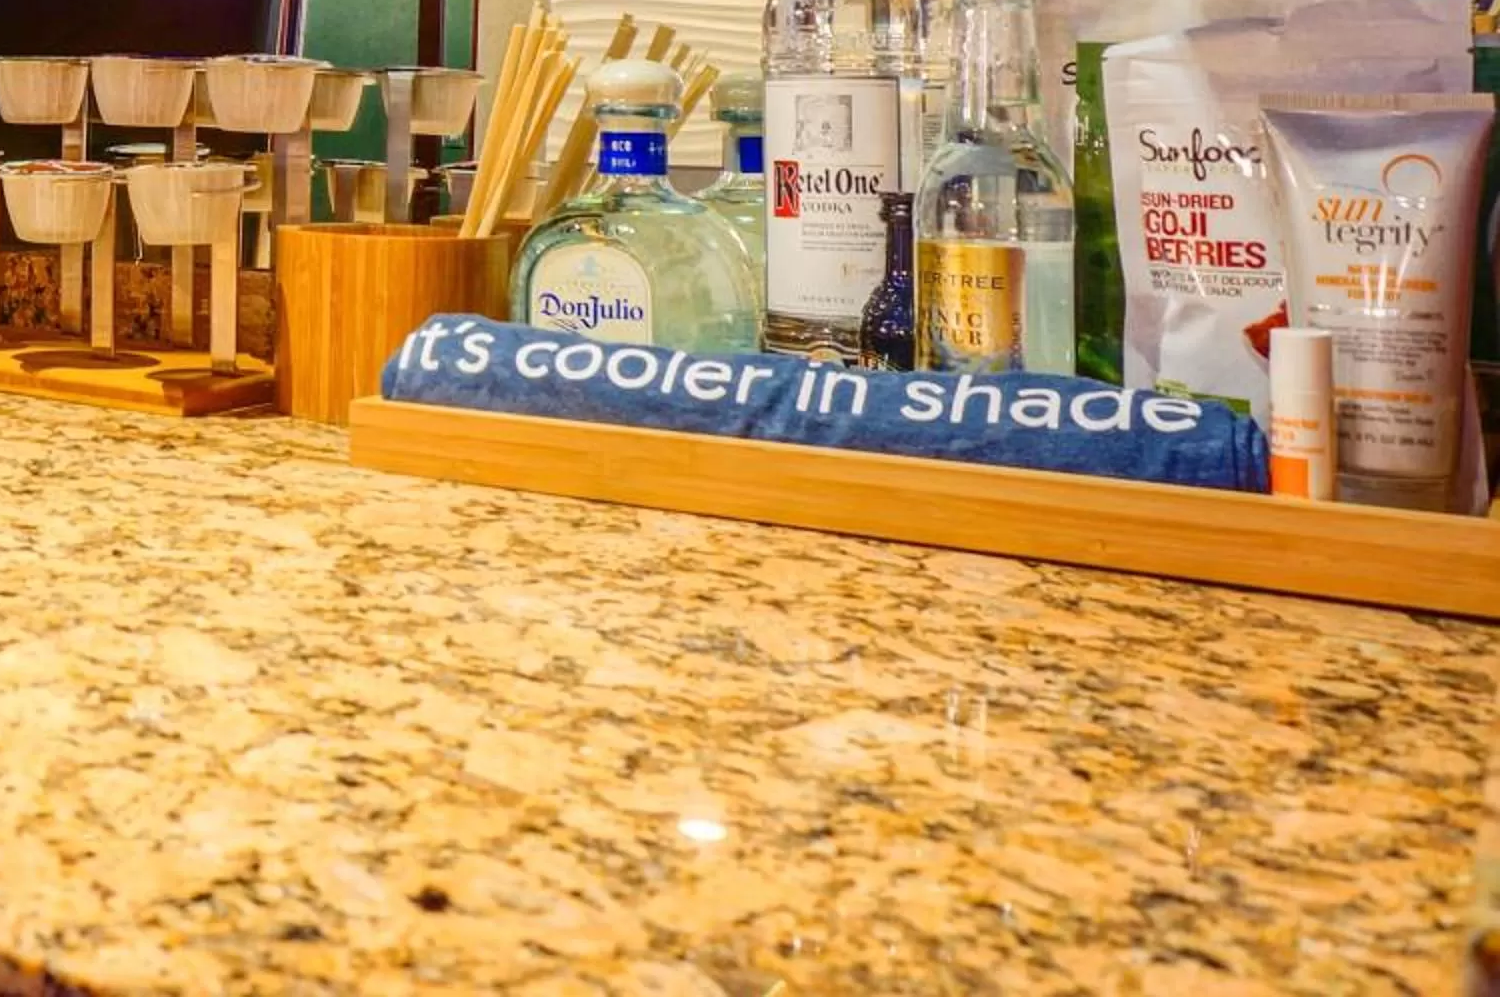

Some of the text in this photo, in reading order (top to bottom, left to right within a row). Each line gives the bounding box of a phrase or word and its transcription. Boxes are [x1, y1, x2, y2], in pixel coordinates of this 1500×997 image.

[773, 160, 880, 218] Ketel One
[1141, 192, 1235, 210] SUN-DRIED
[802, 202, 853, 214] VODKA
[1145, 209, 1208, 237] GOJI
[1311, 196, 1384, 222] sun
[1324, 215, 1436, 258] tegrity
[1146, 236, 1267, 269] BERRIES
[399, 321, 1202, 432] it's cooler in shade
